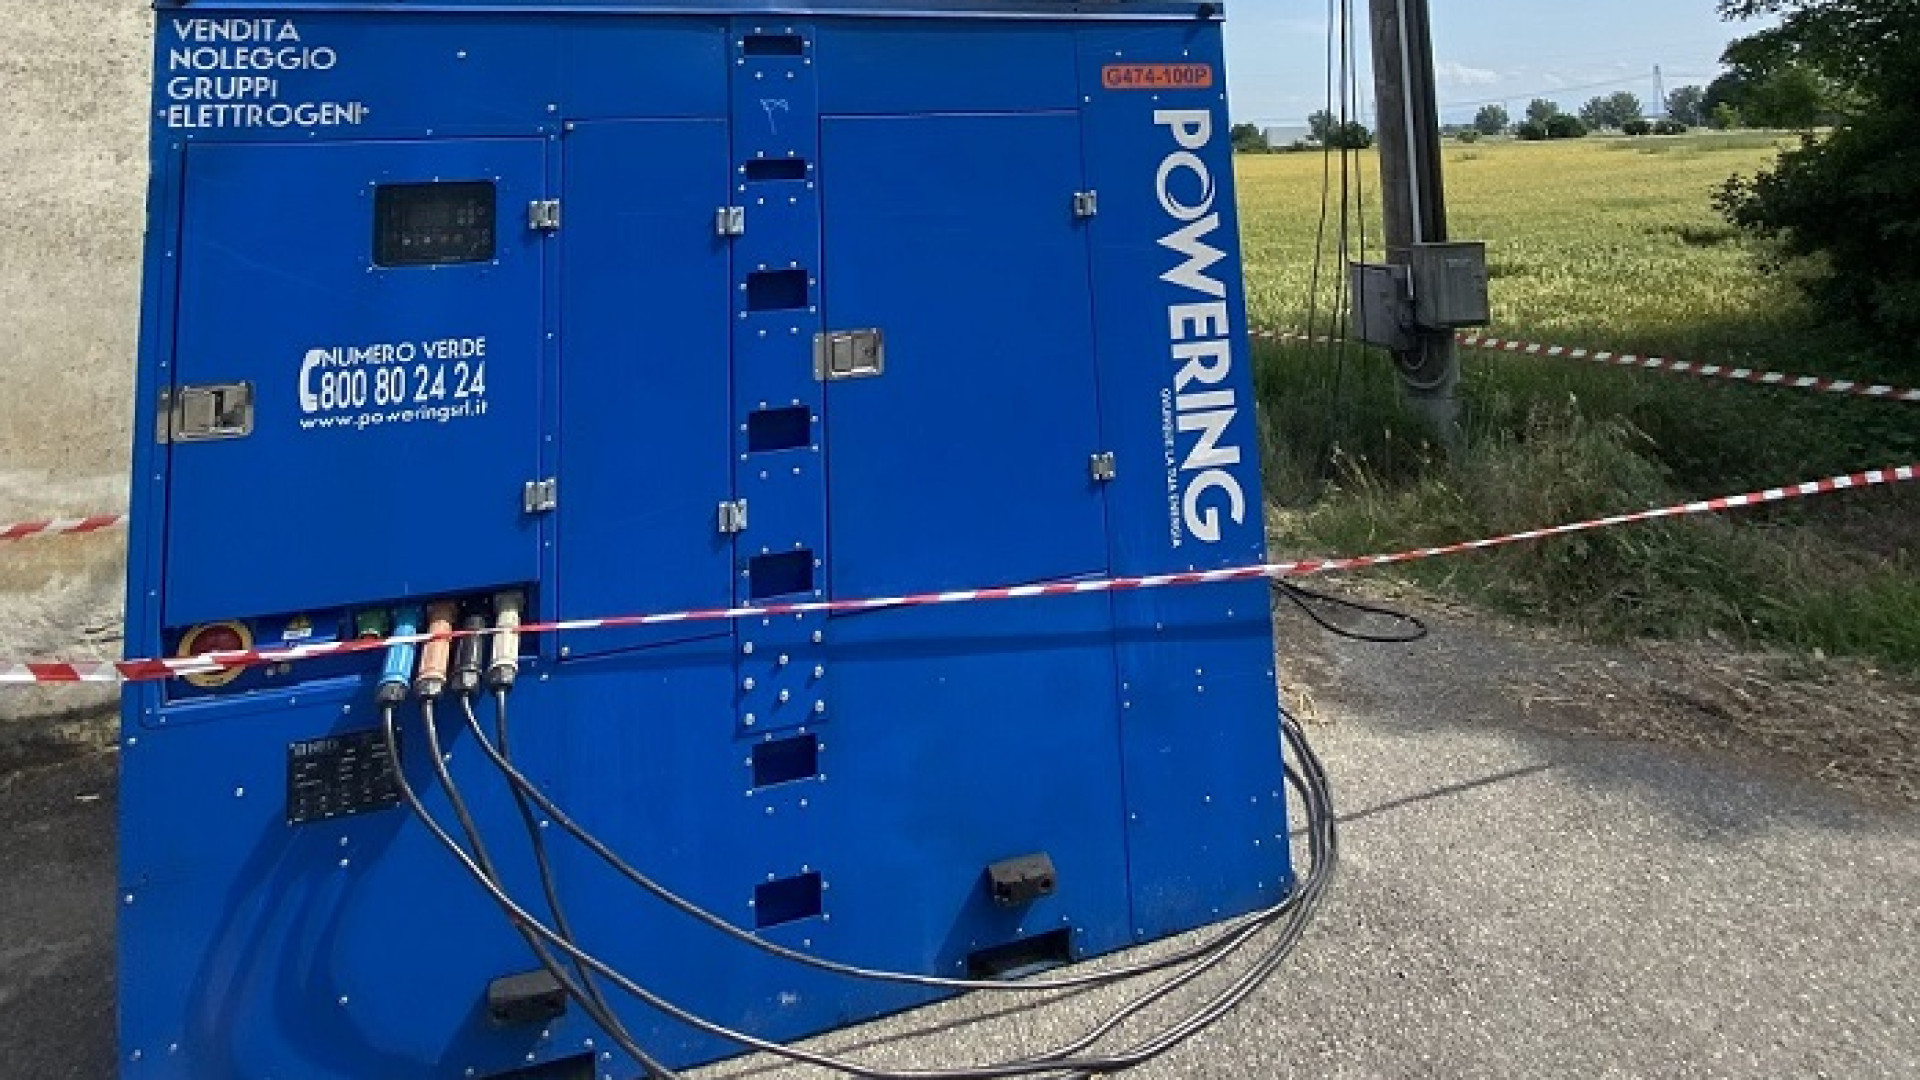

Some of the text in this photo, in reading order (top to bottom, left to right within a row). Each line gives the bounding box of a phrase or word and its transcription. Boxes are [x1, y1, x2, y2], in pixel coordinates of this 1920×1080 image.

[173, 19, 300, 41] VENDITA
[170, 47, 337, 70] NOLEGGIO
[168, 77, 279, 99] GRUPPI
[1107, 67, 1208, 86] G474-100P
[168, 102, 362, 127] ELETTROGENI
[1154, 109, 1245, 541] POWERING
[321, 336, 486, 367] NUMERO VERDE
[321, 361, 486, 410] 800 80 24 24
[300, 399, 488, 430] www.poweringsrl.it
